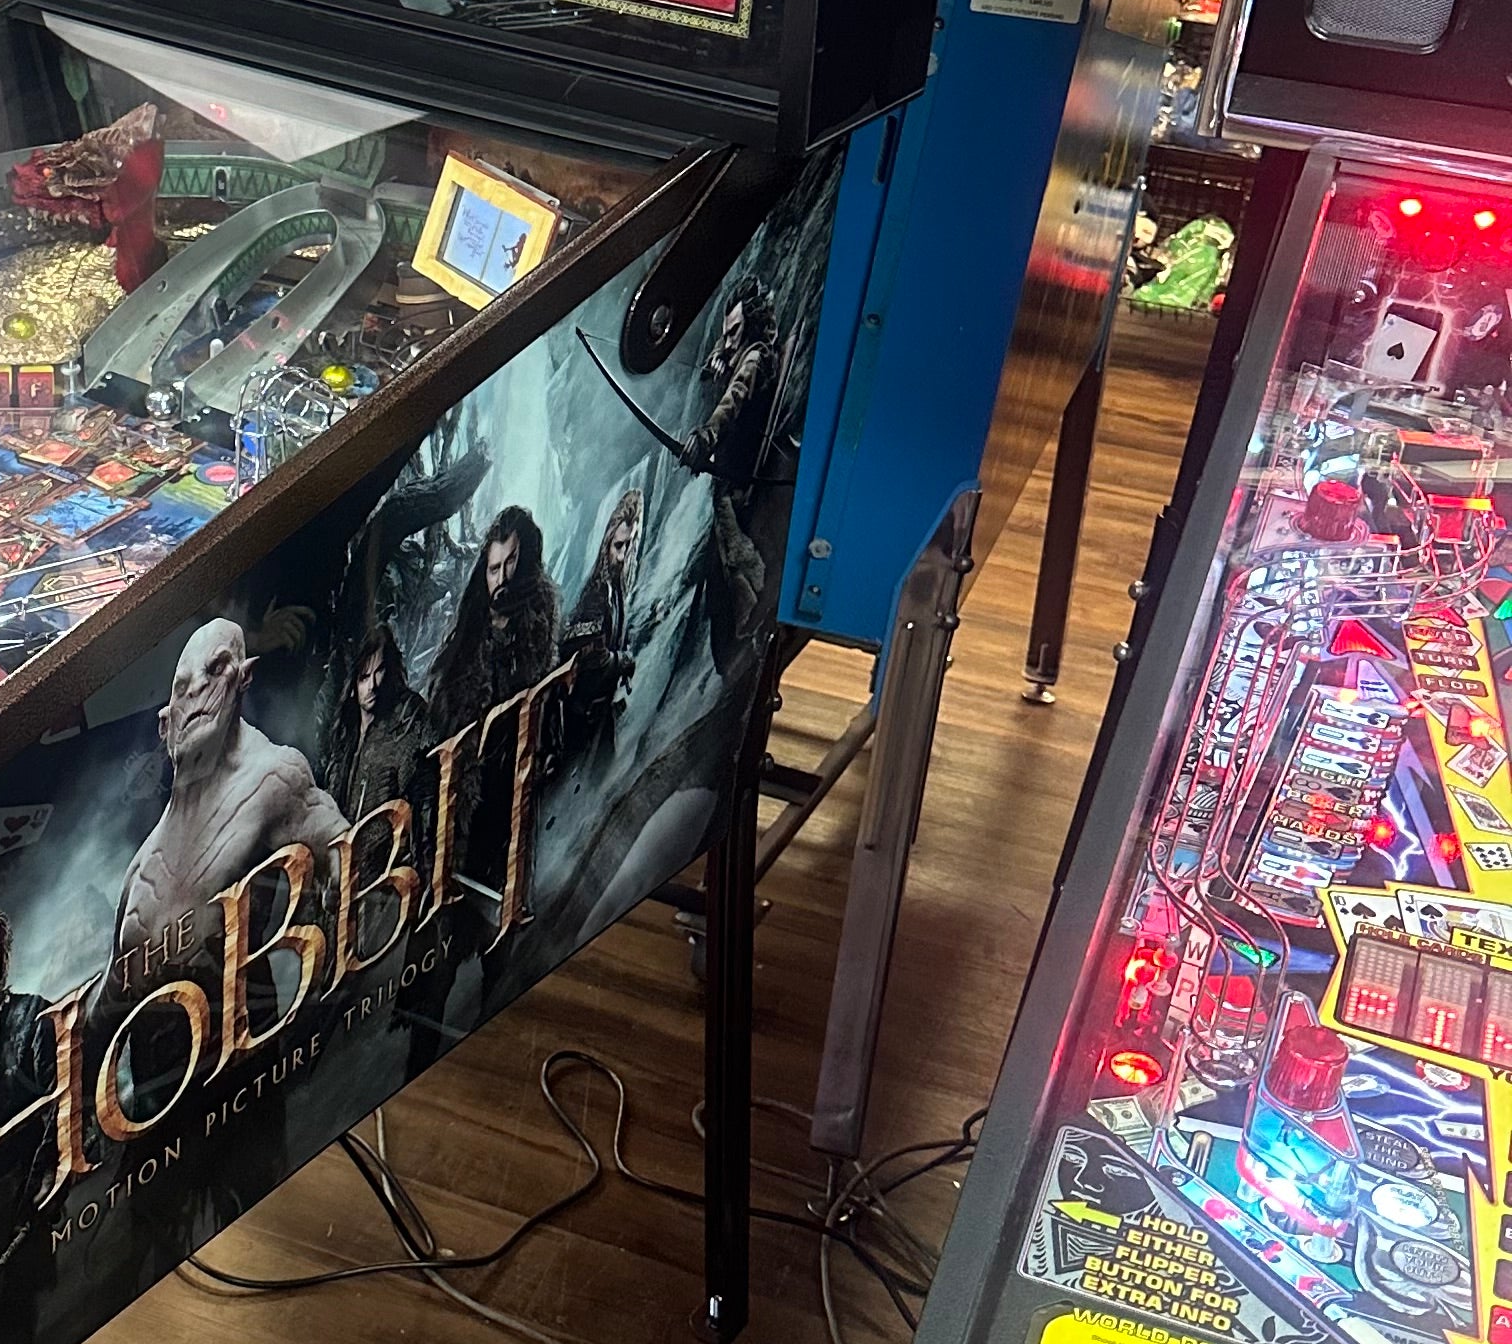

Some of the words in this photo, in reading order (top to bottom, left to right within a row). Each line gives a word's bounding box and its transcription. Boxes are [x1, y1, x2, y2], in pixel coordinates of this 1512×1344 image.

[1416, 652, 1474, 668] TURN
[1425, 677, 1480, 692] FLOP
[1300, 765, 1366, 788] LIGHT
[1286, 789, 1364, 818] POKER
[1270, 810, 1358, 845] HANDS
[1405, 895, 1414, 905] J
[115, 910, 195, 992] THE
[1359, 924, 1411, 946] HOLE
[1416, 938, 1485, 962] CARDS
[48, 1137, 182, 1255] MOTION
[204, 1033, 322, 1137] PICTURE
[341, 934, 456, 1029] TRILOGY
[1366, 1130, 1411, 1151] STEAL
[1142, 1215, 1209, 1245] HOLD
[1126, 1229, 1216, 1267] EITHER
[1115, 1245, 1217, 1287] FLIPPER
[1084, 1256, 1183, 1297] BUTTON
[1190, 1288, 1240, 1314] FOR
[1082, 1274, 1164, 1311] EXTRA
[1170, 1301, 1231, 1332] INFO
